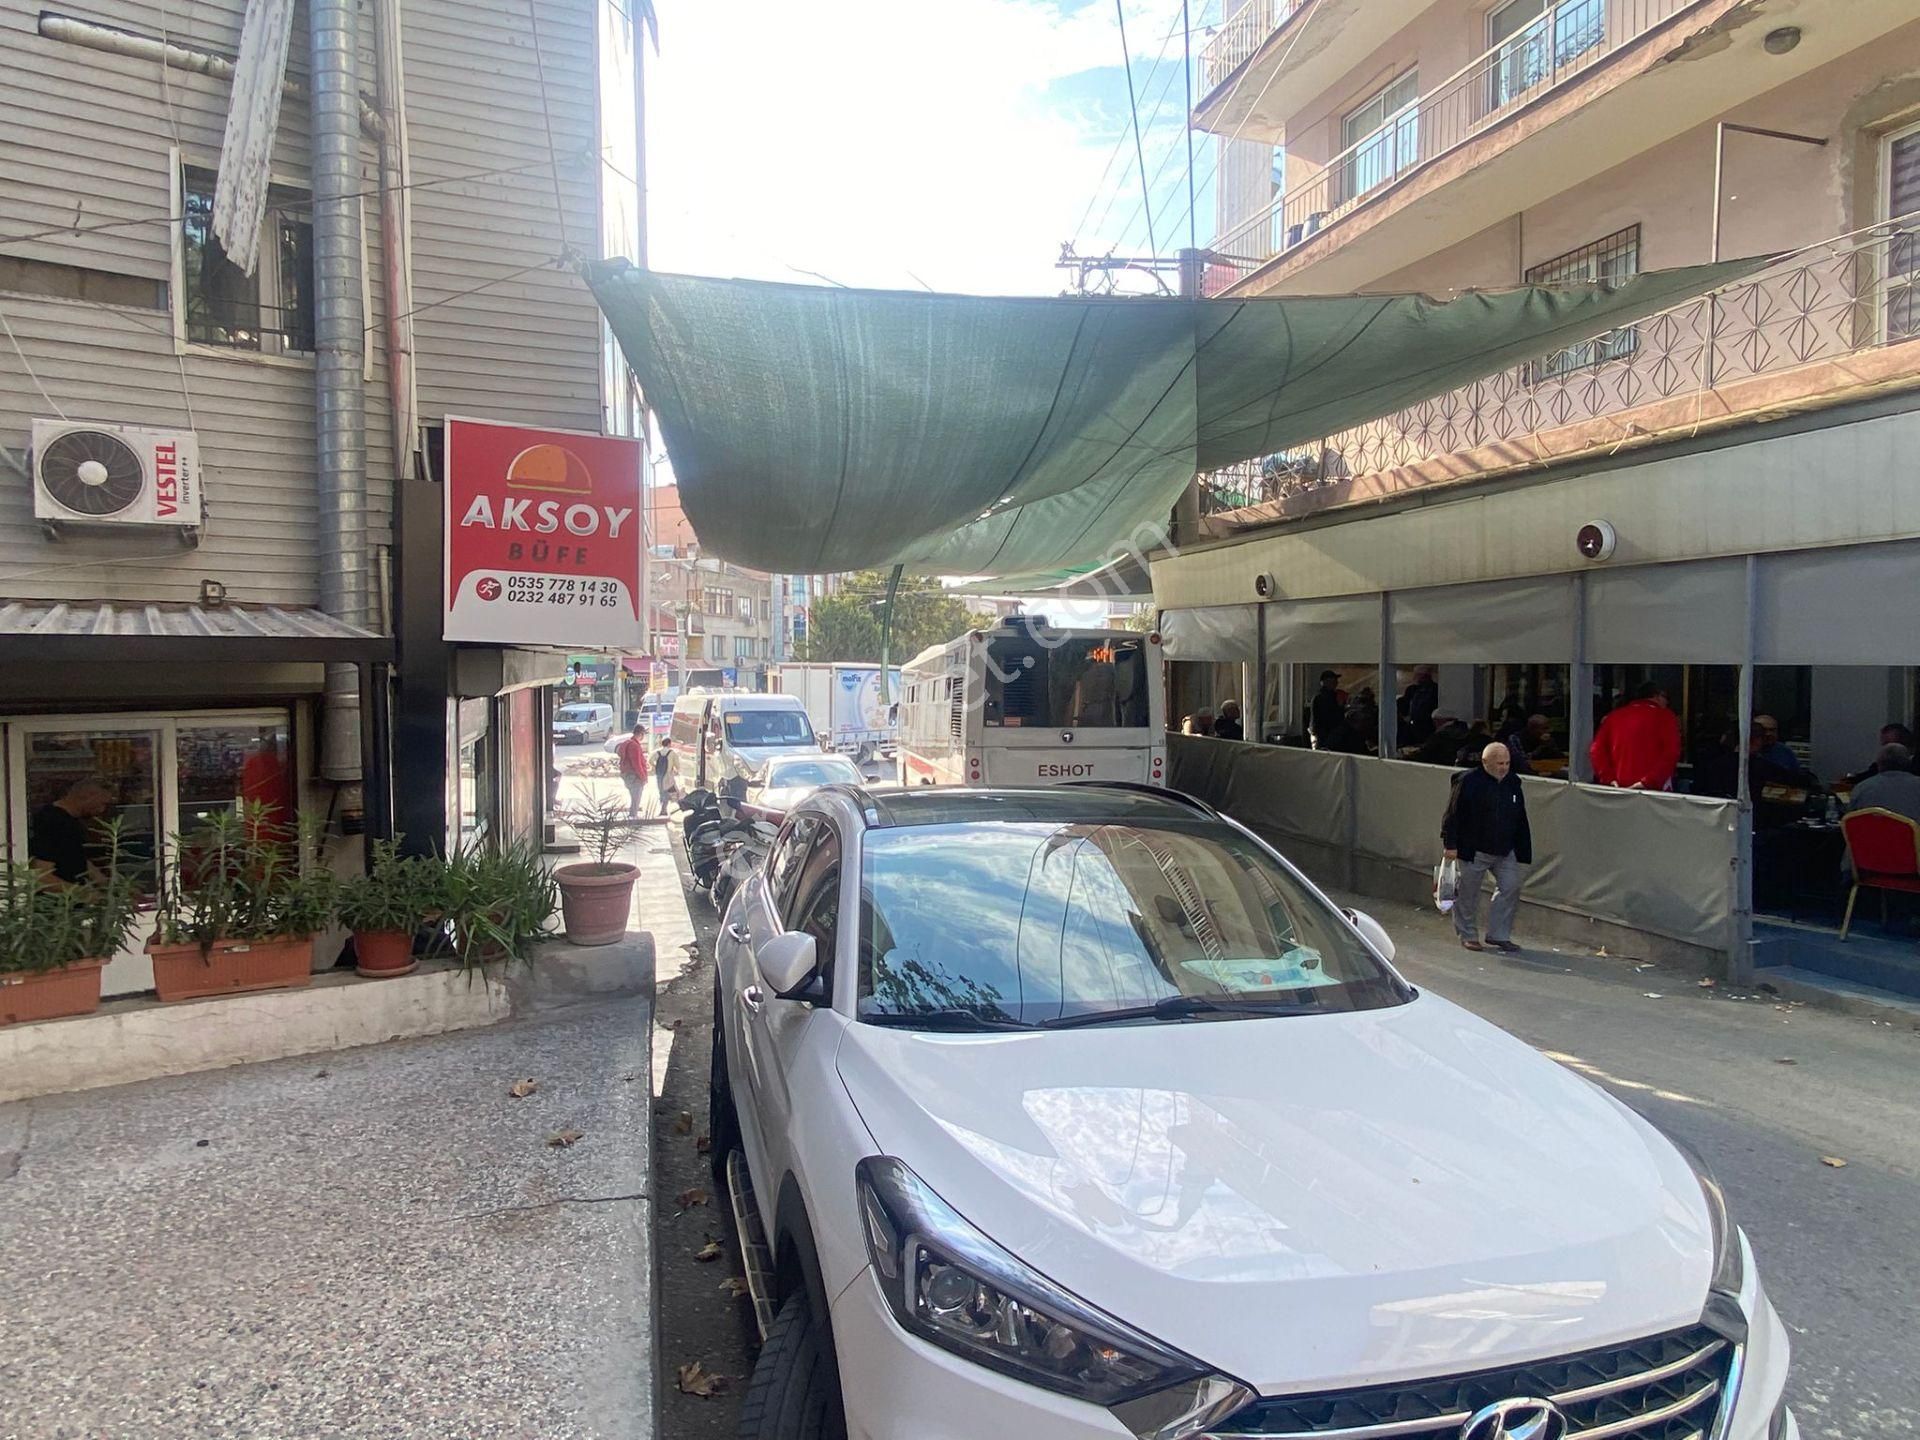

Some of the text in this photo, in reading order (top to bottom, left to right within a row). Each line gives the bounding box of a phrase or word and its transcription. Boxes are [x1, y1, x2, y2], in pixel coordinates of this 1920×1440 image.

[156, 441, 177, 517] VESTEL
[460, 495, 633, 538] AKSOY
[509, 539, 588, 565] BÜFE
[508, 576, 618, 594] 0535 778 14 30
[507, 590, 618, 607] 0232 487 91 65
[1037, 764, 1095, 777] ESHOT
